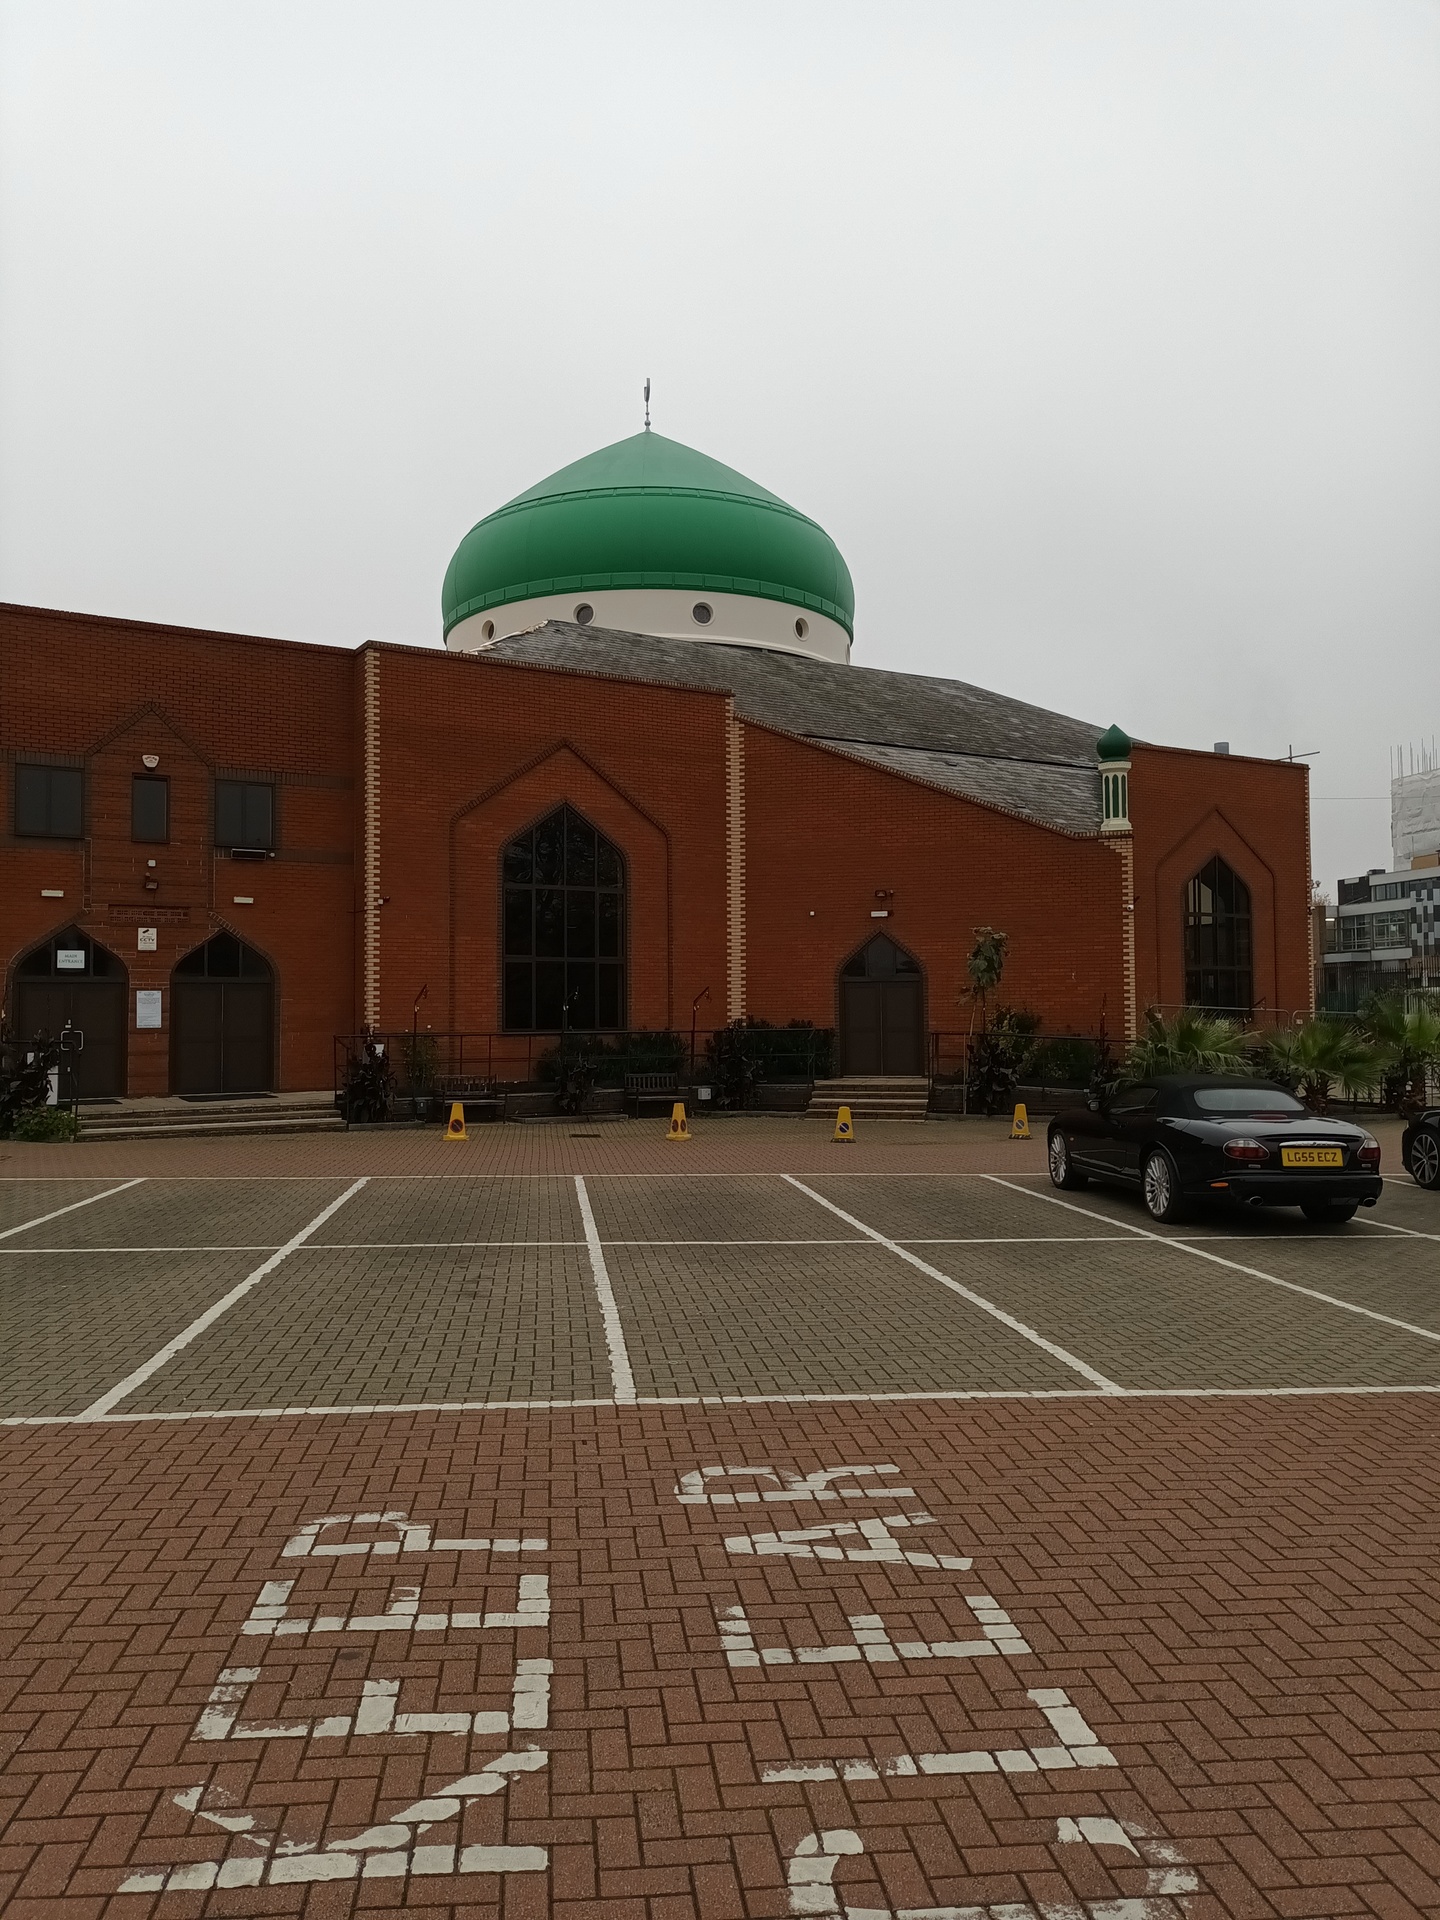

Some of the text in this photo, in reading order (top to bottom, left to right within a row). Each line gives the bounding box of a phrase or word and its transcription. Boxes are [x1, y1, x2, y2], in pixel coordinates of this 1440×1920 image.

[1287, 1152, 1338, 1162] LG55 ECZ
[117, 1511, 550, 1893] KEEP
[673, 1464, 1199, 1920] CLEAR
